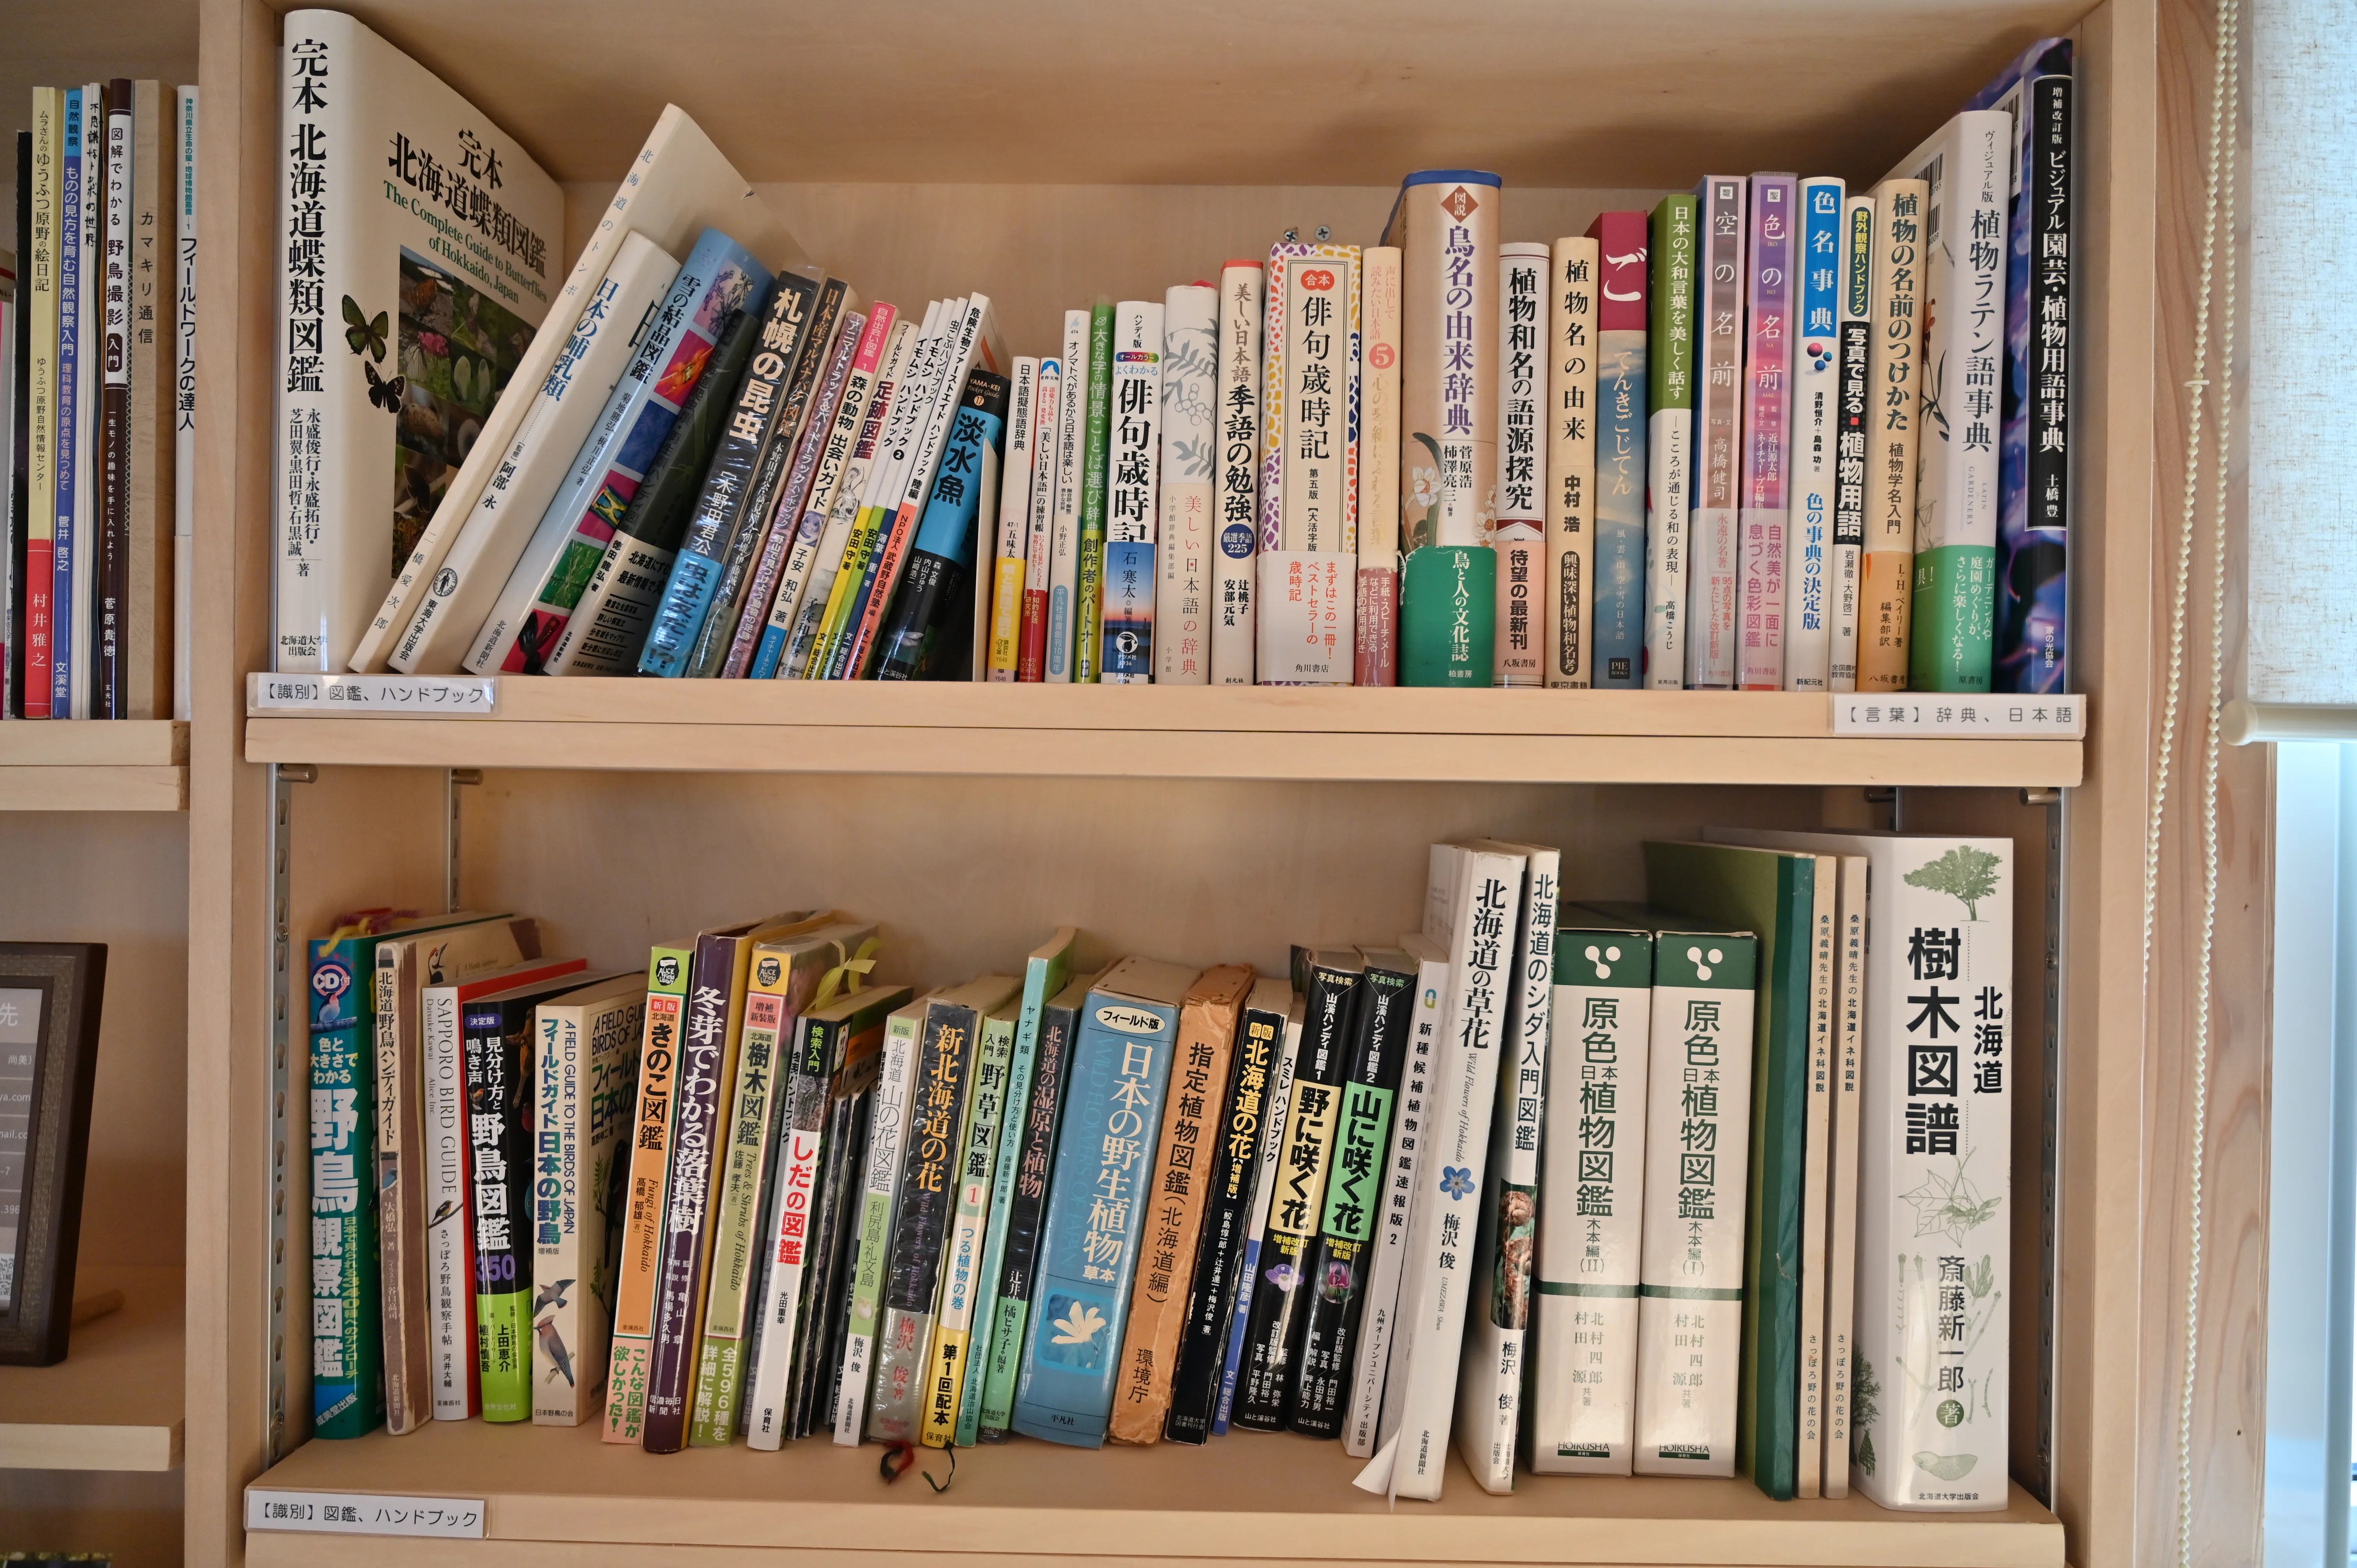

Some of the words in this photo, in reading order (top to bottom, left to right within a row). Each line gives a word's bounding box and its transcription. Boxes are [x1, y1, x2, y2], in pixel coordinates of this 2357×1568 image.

[292, 39, 328, 114] 完本
[68, 99, 79, 147] 自然観察
[458, 129, 503, 190] 完本
[35, 111, 50, 291] ムラさんのゆうふつ原野の絵日記
[109, 128, 123, 226] 図解でわかる
[1454, 192, 1466, 217] 図説
[1981, 131, 1995, 203] ヴィジュアル版
[62, 167, 78, 356] ものの見方を育む自然観察入門
[287, 124, 327, 393] 北海道蝶類図鑑
[383, 181, 408, 210] The
[411, 198, 463, 243] Complete
[465, 231, 493, 263] Guide
[495, 254, 504, 272] to
[505, 259, 547, 304] Butterflies
[565, 149, 654, 297] 北海道のトンボ
[1809, 191, 1836, 331] 色名事典
[1852, 211, 1868, 314] 野外観察ハンドブック
[107, 240, 124, 325] 野鳥撮影
[138, 212, 154, 343] カマキリ通信
[429, 237, 441, 253] of
[442, 244, 493, 289] Hokkaido,
[494, 275, 519, 305] Japan
[1370, 266, 1382, 340] 読みたい日本語
[1385, 266, 1396, 320] 声に出して
[1668, 207, 1690, 401] 日本の大和言葉を美しく話す
[1710, 211, 1738, 387] 空の名前
[1756, 214, 1785, 390] 色の名前
[1886, 192, 1918, 431] 植物の名前のつけかた
[107, 339, 120, 368] 入門
[178, 238, 197, 431] フィールドワークの達人
[541, 277, 620, 401] 日本の哺乳類
[629, 274, 701, 385] 雪の結晶図鑑
[729, 288, 803, 445] 札幌の昆虫
[776, 288, 840, 439] 日本産マルハナバチ図鑑
[864, 307, 889, 358] 自然出会い図鑑
[885, 324, 910, 379] フィールドガイド
[924, 320, 959, 404] 虫こぶハンドブック
[937, 306, 981, 420] 危険生物ファーストエイド
[1115, 365, 1158, 376] よくわかる
[1133, 314, 1143, 348] ハンディ版
[1444, 225, 1475, 435] 鳥名の由来辞典
[1562, 260, 1588, 440] 植物名の由来
[1845, 328, 1867, 415] 写真で見る
[1961, 209, 2000, 453] 植物ラテン語事典
[837, 376, 867, 431] 森の動物
[969, 378, 1001, 392] YAMA-KEI
[1014, 365, 1031, 451] 日本語擬態語辞典
[1061, 342, 1079, 484] オノマトペがあるから日本語は楽しい
[1299, 296, 1332, 460] 俳句歳時記
[1505, 267, 1537, 511] 植物和名の語源探究
[36, 358, 46, 491] ゆうふつ原野自然情報センター
[855, 381, 893, 461] 足跡図鑑
[916, 424, 941, 476] ハンドブック
[934, 413, 987, 507] 淡水魚
[1612, 351, 1633, 496] てんきごじてん
[1767, 433, 1778, 482] 近江源太郎
[813, 434, 848, 509] 出会いガイド
[907, 478, 923, 500] 陸編
[1035, 427, 1051, 533] 「美しい日本語」の練習帳
[1308, 468, 1319, 500] 第五版
[1564, 475, 1581, 508] 中村
[1837, 432, 1865, 538] 植物用語
[1886, 442, 1904, 535] 植物学名入門
[57, 547, 69, 572] 啓之
[58, 516, 69, 540] 菅井
[1058, 526, 1067, 556] 小野正弘
[1228, 544, 1247, 554] 225
[1564, 516, 1580, 533] 浩
[1716, 513, 1728, 568] 永遠の名著
[1802, 492, 1824, 631] 色の事典の決定版
[1081, 538, 1098, 654] 創作者のパートナー
[1180, 495, 1201, 676] 美しい日本語の辞典
[1223, 579, 1235, 627] 安部元気
[1288, 561, 1302, 602] 歳時記
[1306, 562, 1320, 645] ベストセラーの
[1451, 551, 1470, 662] 鳥と人の文化誌
[1510, 549, 1528, 651] 待望の最新刊
[1562, 554, 1578, 672] 興味深い植物和名考
[1745, 524, 1763, 648] 息づく色彩図鑑
[1765, 524, 1782, 647] 自然美が一面に
[32, 593, 48, 667] 村井雅之
[104, 598, 115, 656] 菅原貴徳
[476, 620, 507, 669] 北海道新聞社
[1295, 664, 1329, 673] 角川書店
[1611, 662, 1628, 670] PIE
[2044, 626, 2054, 668] 家の光協会
[1747, 667, 1776, 676] 角川書店
[1958, 676, 1983, 685] 原書房
[1458, 878, 1507, 1049] 北海道の草花
[1815, 914, 1830, 1092] 桑原義晴先生の北海道イネ科図説
[1845, 914, 1859, 1092] 桑原義晴先生の北海道イネ科図説
[318, 1037, 344, 1052] 色と
[437, 998, 455, 1081] SAPPORO
[470, 1017, 495, 1026] 決定版
[565, 1020, 576, 1029] A
[565, 1031, 576, 1061] FIELD
[1514, 874, 1554, 1151] 北海道のシダ入門図鑑
[1905, 927, 1961, 1155] 樹木図譜
[1973, 986, 2003, 1094] 北海道
[310, 1052, 359, 1068] 大きさで
[314, 1070, 352, 1084] わかる
[378, 972, 396, 1146] 北海道野鳥ハンディガイド
[466, 1038, 482, 1087] 鳴き声
[486, 1037, 505, 1109] 見分け方と
[541, 1018, 560, 1129] フィールドガイド
[564, 1064, 576, 1098] GUIDE
[638, 1023, 673, 1150] きのこ図鑑
[736, 1042, 771, 1147] 樹木図鑑
[887, 1039, 907, 1083] 北海道
[1229, 1039, 1270, 1160] 北海道の花
[1280, 1057, 1294, 1090] スミレ
[439, 1087, 455, 1129] BIRD
[564, 1102, 576, 1119] TO
[564, 1121, 575, 1141] THE
[668, 986, 726, 1235] 冬芽でわかる落葉樹
[869, 1086, 902, 1193] 山の花図鑑
[915, 1024, 965, 1192] 新北海道の花
[966, 1062, 1005, 1179] 野草図鑑
[1018, 1025, 1062, 1198] 北海道の湿原と植物
[1265, 1097, 1287, 1162] ハンドブック
[1576, 998, 1619, 1217] 原色日本植物図鑑
[1678, 1000, 1722, 1220] 原色日本植物図鑑
[440, 1136, 457, 1194] GUIDE
[471, 1112, 511, 1251] 野鳥図鑑
[537, 1132, 562, 1245] 日本の野鳥
[564, 1144, 575, 1177] BIRDS
[564, 1181, 575, 1196] OF
[1083, 1041, 1154, 1266] 日本の野生植物
[1279, 1086, 1331, 1231] 野に咲く花
[1333, 1090, 1382, 1234] 山に咲く花
[310, 1088, 359, 1378] 野鳥観察図鑑
[563, 1198, 574, 1234] JAPAN
[776, 1136, 814, 1266] しだの図鑑
[440, 1229, 453, 1346] さっぽろ野鳥観察手帖
[777, 1291, 788, 1324] 光田重幸
[951, 1227, 974, 1310] つる植物の巻
[1438, 1277, 1448, 1312] UMEZAWA
[479, 1324, 490, 1372] 植村慎吾
[1435, 1314, 1444, 1331] Shun
[1937, 1255, 1965, 1393] 斎藤新一郎
[443, 1353, 452, 1388] 河井大輔
[625, 1348, 645, 1438] こんな図鑑が
[712, 1346, 738, 1441] 全596種を
[1806, 1334, 1818, 1440] さっぽろ野の花の会
[1834, 1333, 1845, 1439] さっぽろ野の花の会
[762, 1407, 772, 1433] 保育社
[1417, 1430, 1430, 1475] 北海道新聞社
[1558, 1441, 1610, 1451] HOIKUSHA
[1659, 1443, 1710, 1453] HOIKUSHA
[1918, 1492, 1979, 1501] 北海道大学出版会
